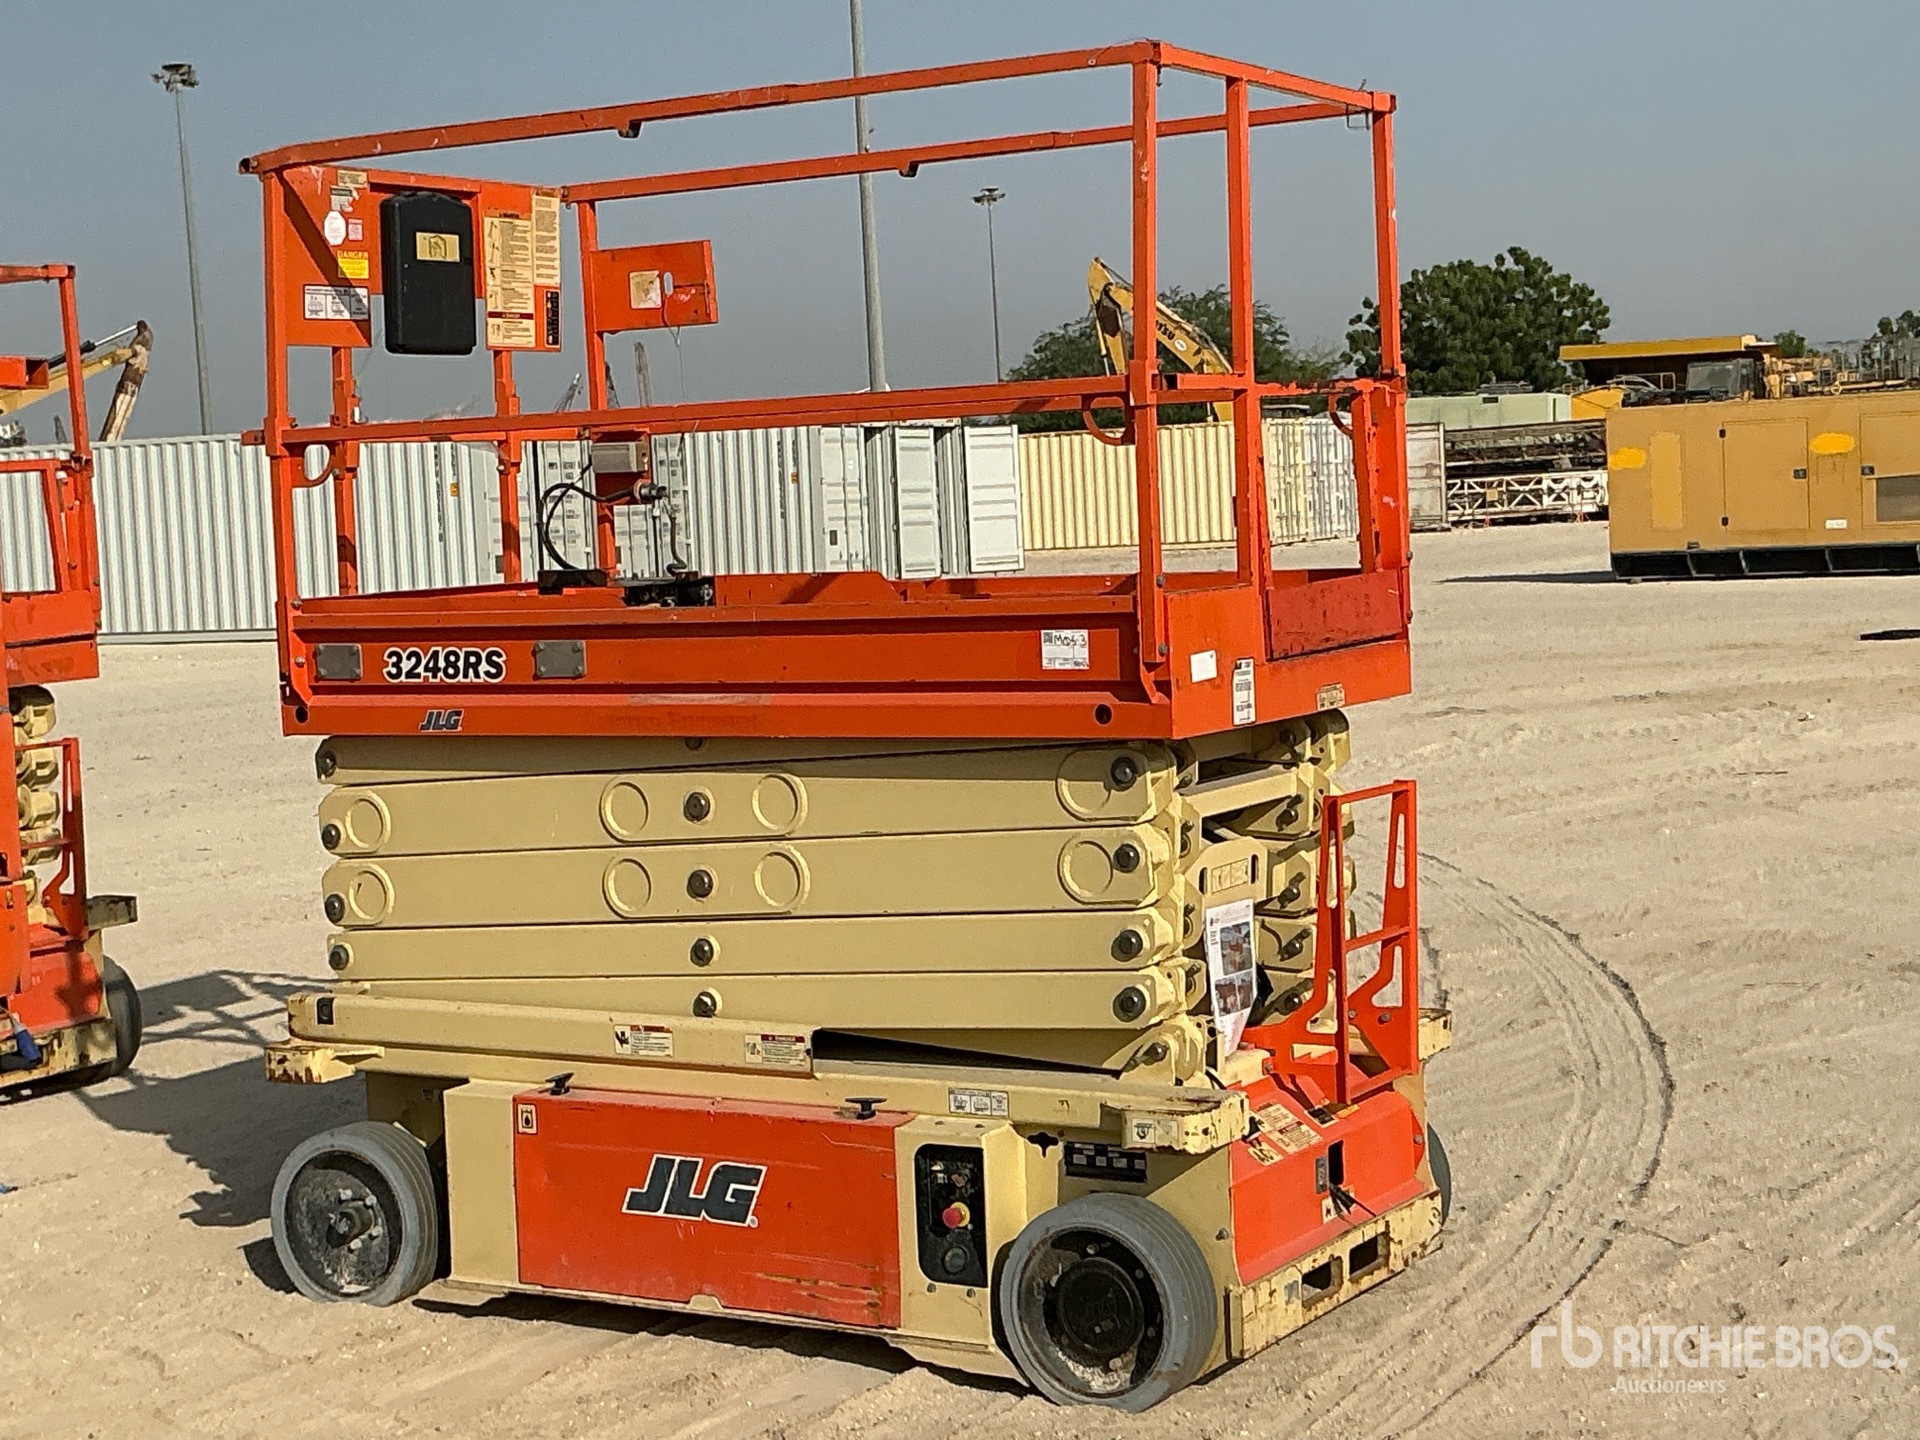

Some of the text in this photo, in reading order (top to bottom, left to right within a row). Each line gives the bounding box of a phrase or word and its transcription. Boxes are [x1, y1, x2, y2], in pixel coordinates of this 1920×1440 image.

[383, 646, 507, 683] 3248RS
[419, 709, 464, 732] JLG
[621, 1153, 768, 1227] JLG
